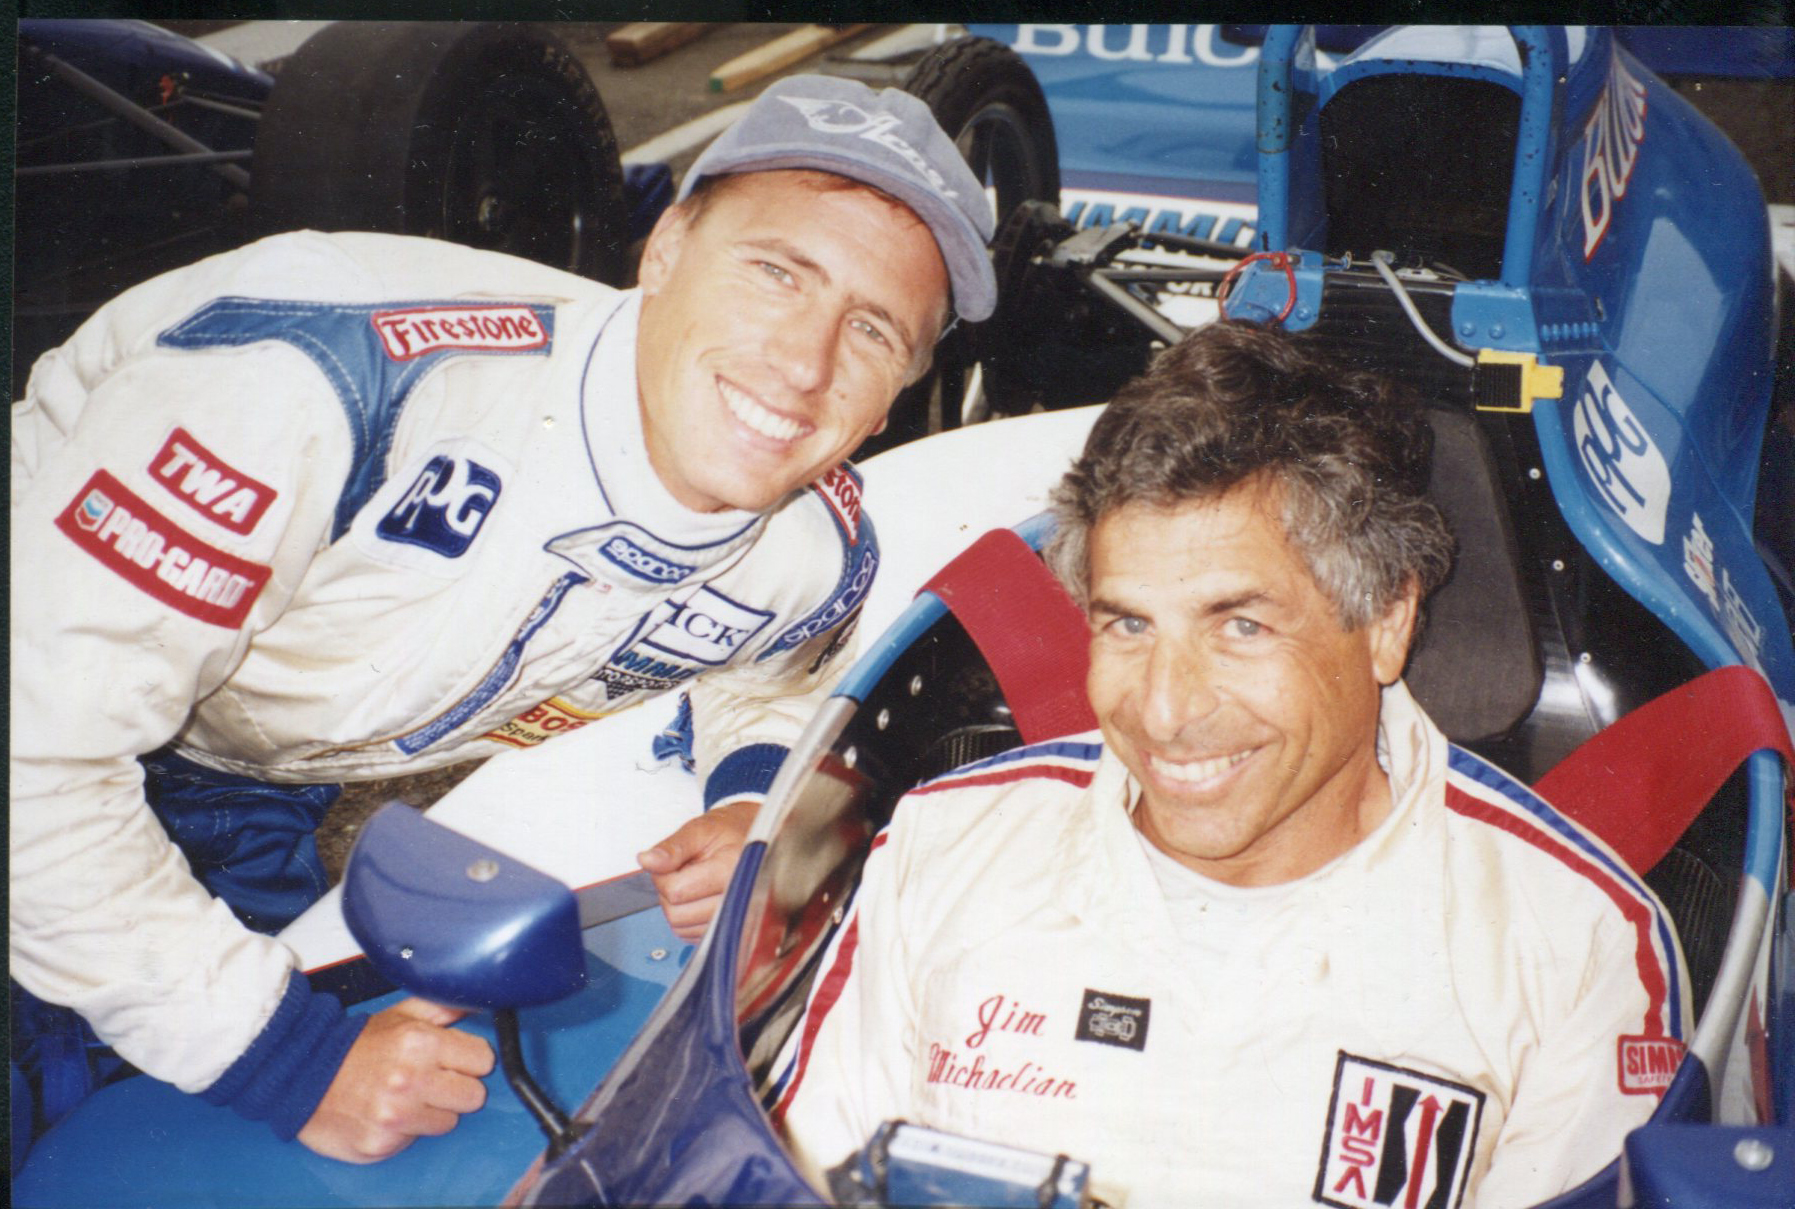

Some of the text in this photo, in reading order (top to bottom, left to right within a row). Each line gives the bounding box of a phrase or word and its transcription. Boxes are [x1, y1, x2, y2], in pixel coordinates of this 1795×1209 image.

[381, 314, 538, 356] Firestone
[159, 442, 259, 523] TWA
[664, 599, 750, 647] ICK
[965, 994, 1048, 1049] Jim
[1333, 1076, 1384, 1200] IMSA
